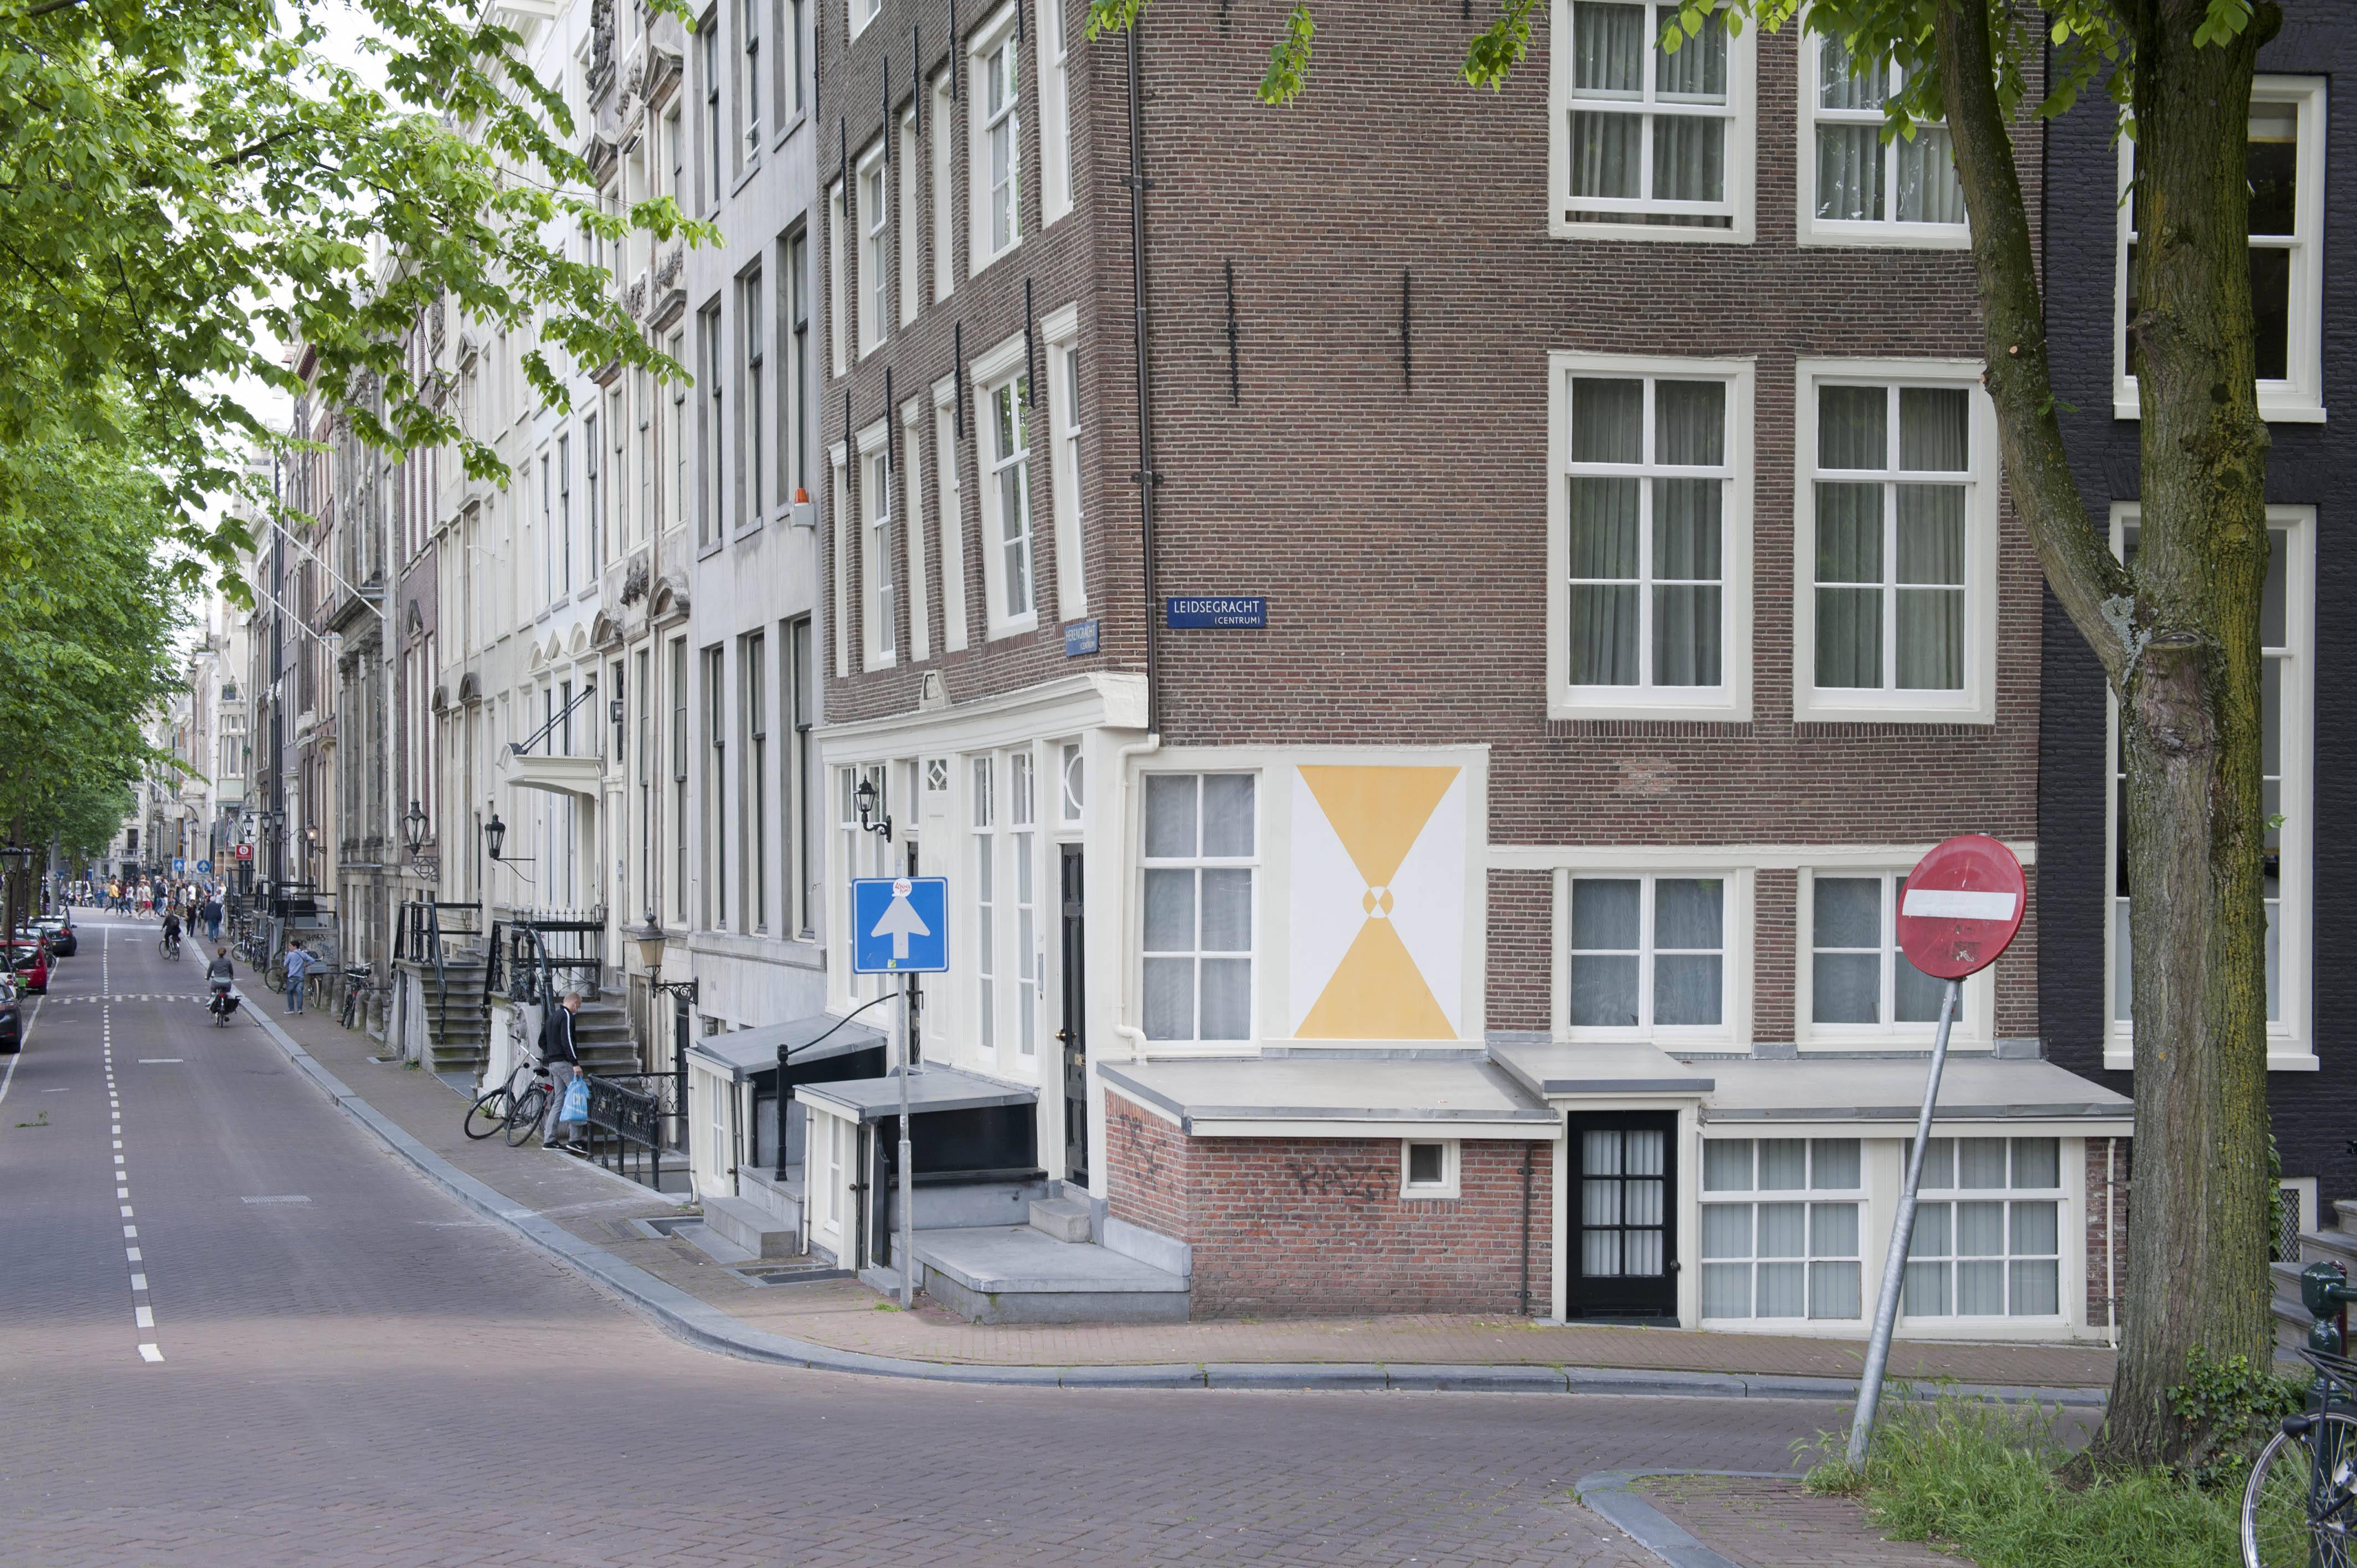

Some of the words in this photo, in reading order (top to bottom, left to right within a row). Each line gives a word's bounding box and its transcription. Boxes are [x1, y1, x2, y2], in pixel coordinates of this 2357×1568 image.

[1174, 601, 1259, 613] LEIDSEGRACHT
[1214, 616, 1260, 625] (CENTRUM)
[1066, 625, 1095, 642] HERENGRACHT
